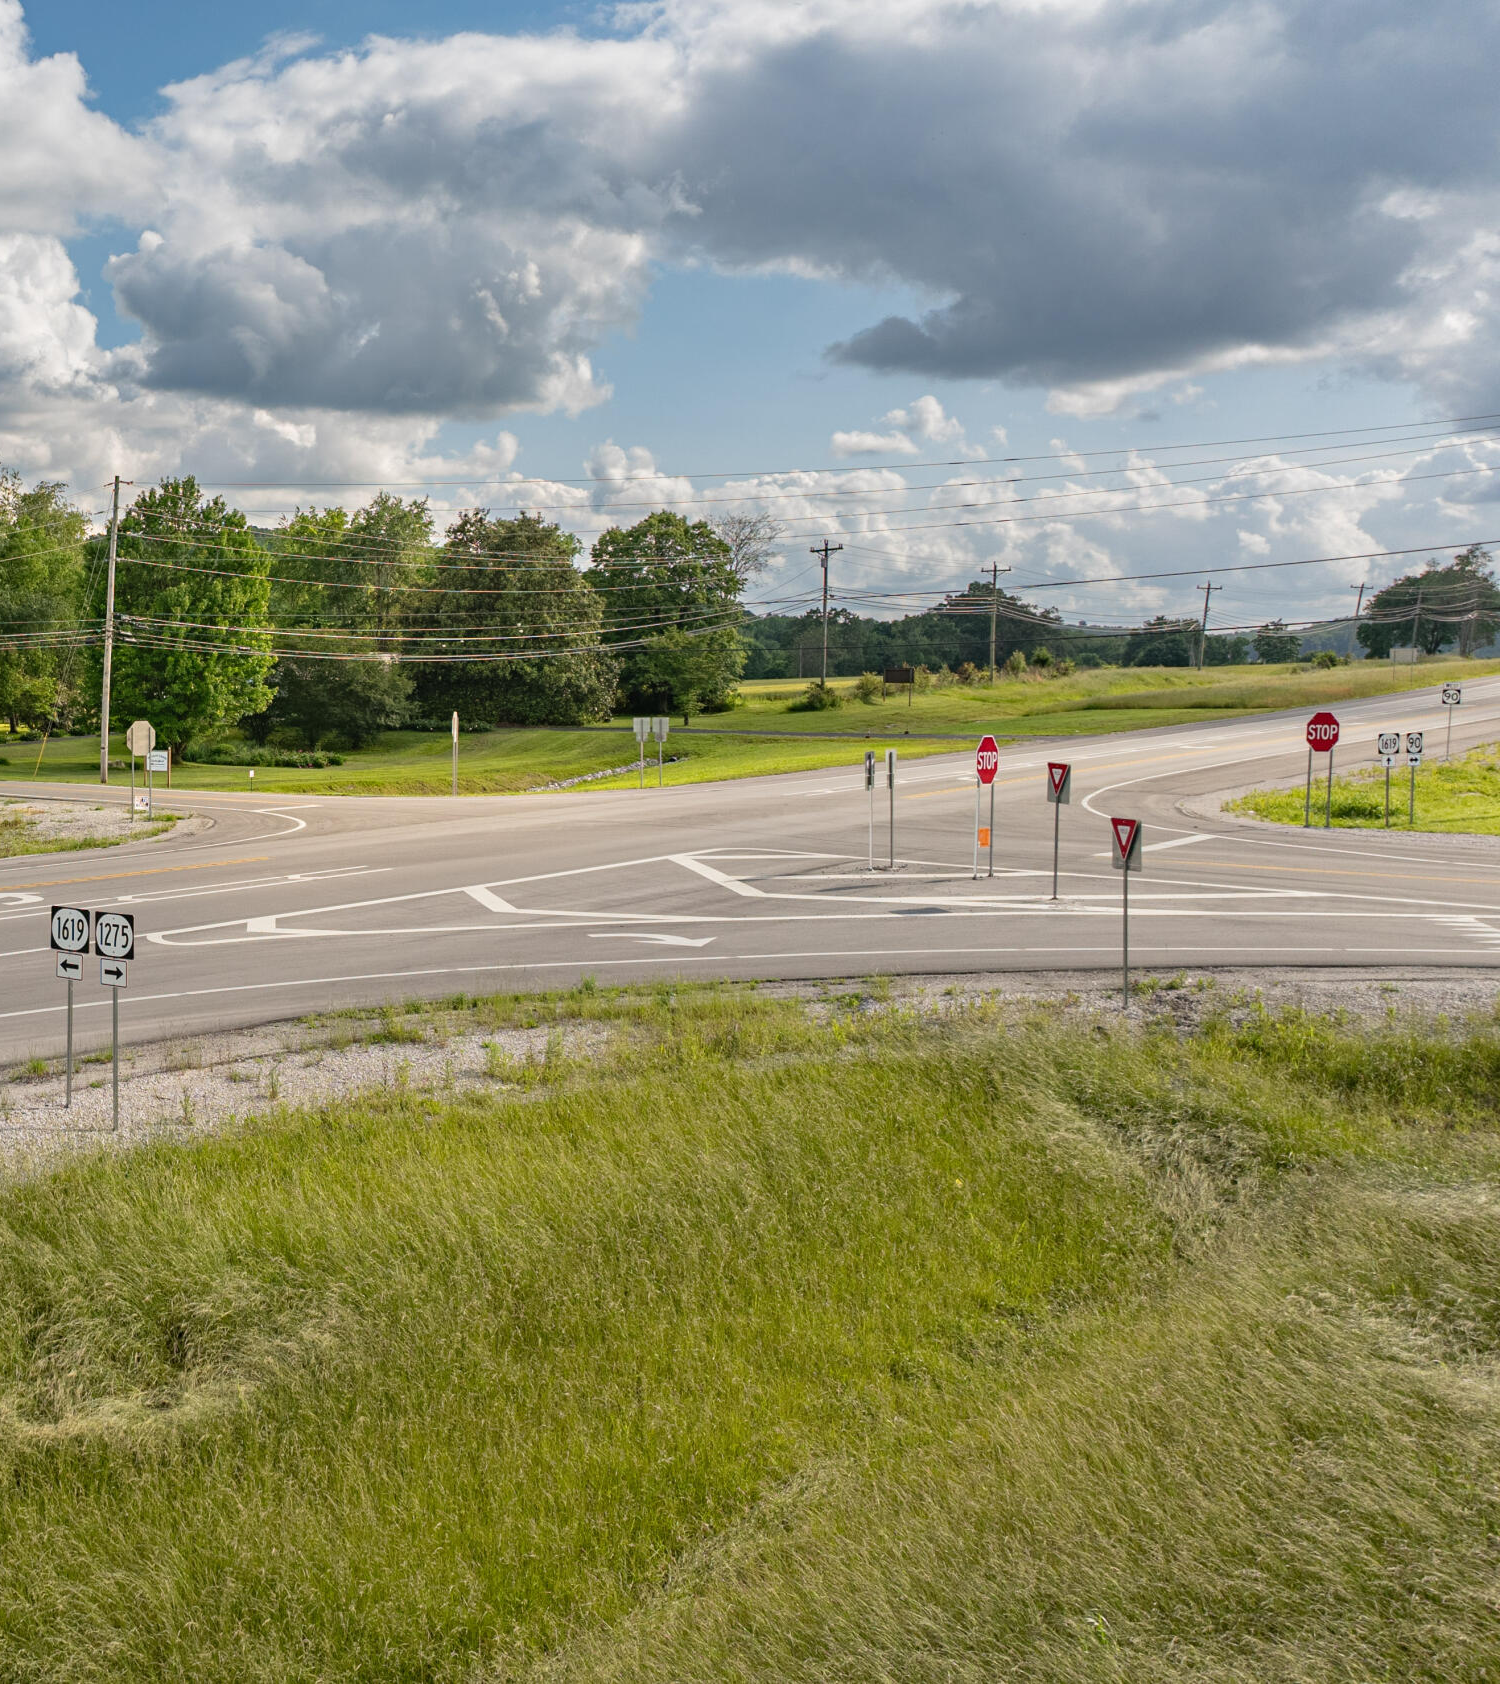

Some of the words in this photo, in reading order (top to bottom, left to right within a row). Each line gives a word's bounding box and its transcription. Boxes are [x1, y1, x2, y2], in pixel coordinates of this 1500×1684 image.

[1444, 692, 1458, 701] 90
[1308, 724, 1338, 740] STOP
[1381, 737, 1397, 749] 1619
[1408, 737, 1421, 748] 90
[977, 751, 998, 770] STOP
[56, 916, 85, 942] 1619
[99, 922, 129, 949] 1275
